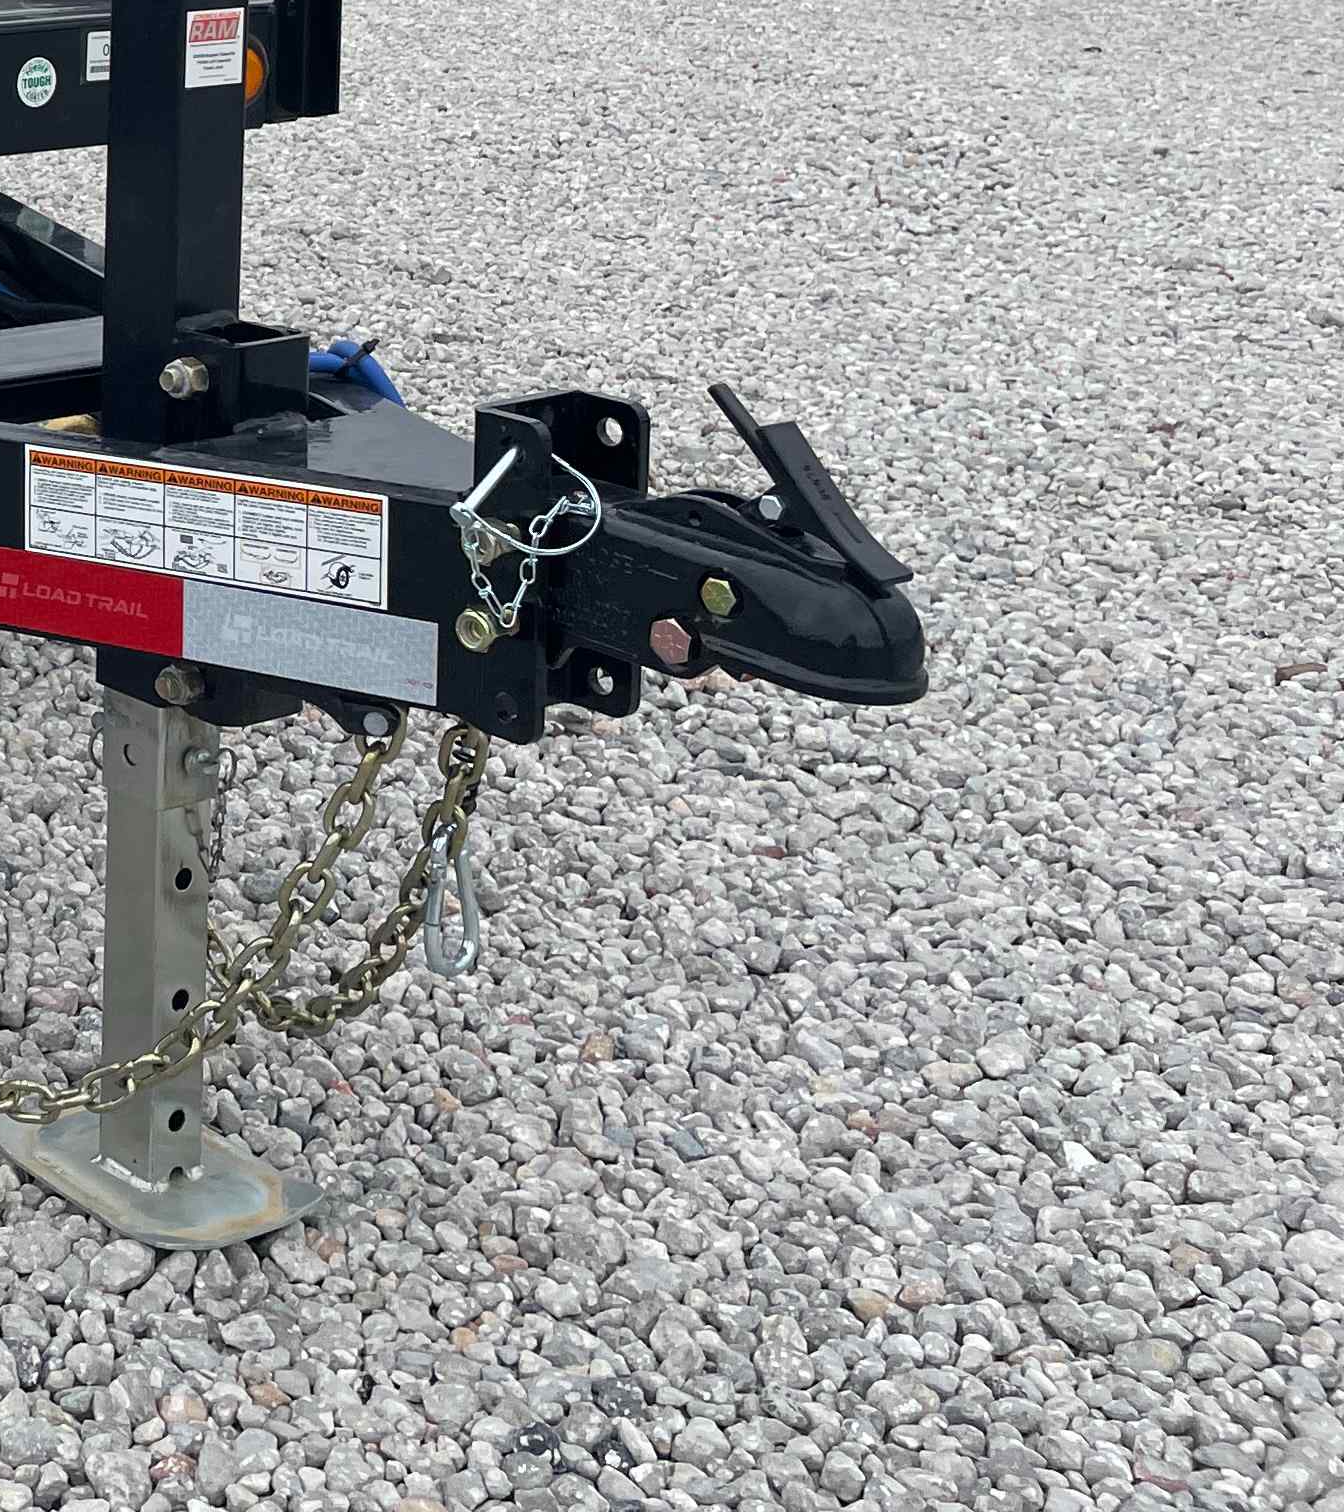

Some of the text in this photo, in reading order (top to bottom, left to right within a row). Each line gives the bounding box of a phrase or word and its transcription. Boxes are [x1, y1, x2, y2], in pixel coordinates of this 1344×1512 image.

[191, 19, 238, 41] RAM
[22, 75, 52, 89] TOUGH
[41, 456, 380, 513] WARNING WARNING WARNING WARNING WARNING
[22, 582, 149, 618] LOAD TRAIL
